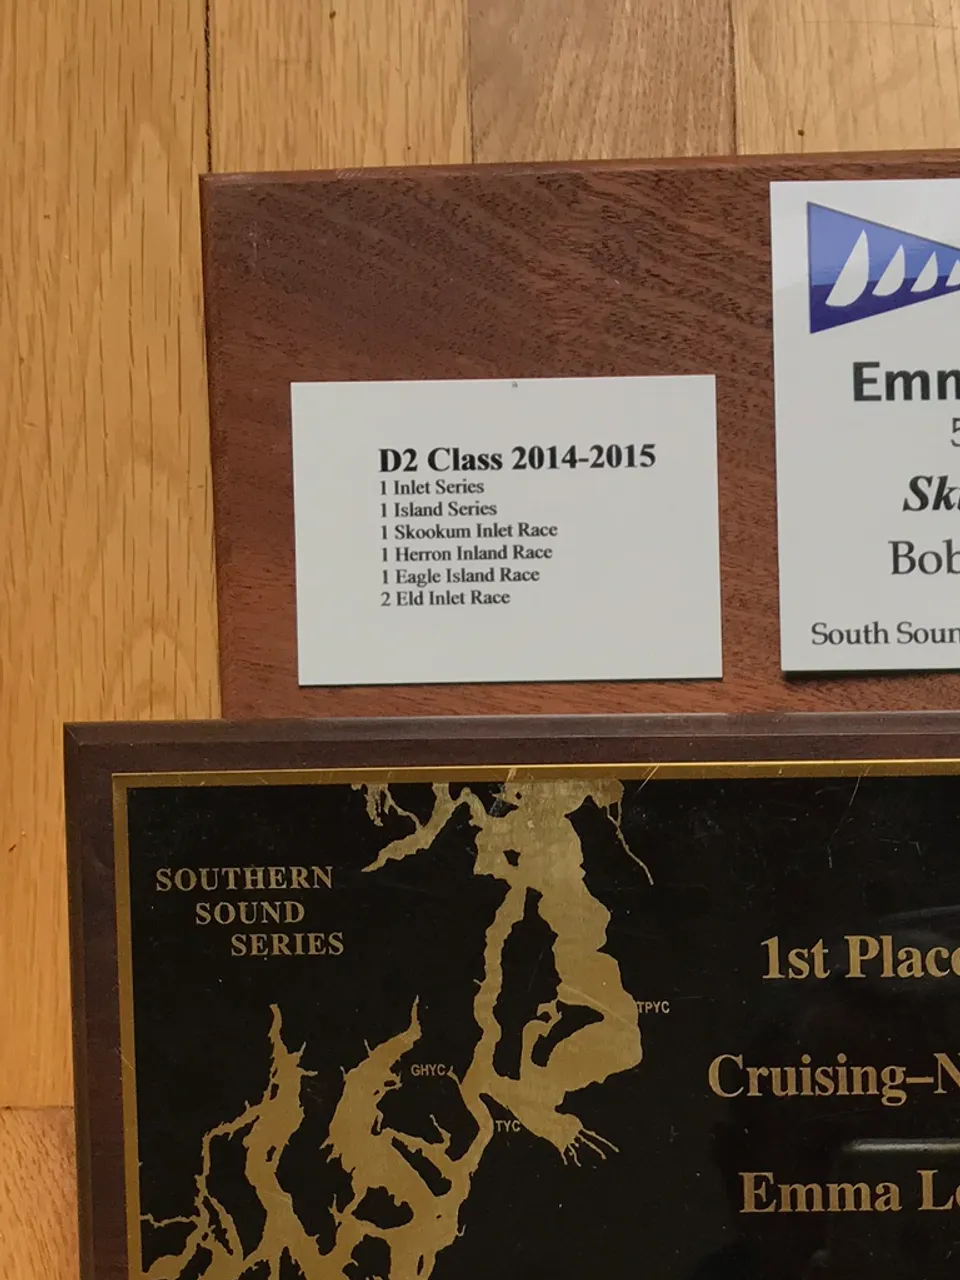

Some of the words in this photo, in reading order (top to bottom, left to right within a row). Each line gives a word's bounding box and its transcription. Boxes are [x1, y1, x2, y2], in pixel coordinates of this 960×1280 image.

[380, 449, 417, 472] D2
[428, 448, 502, 471] Class
[512, 444, 655, 469] 2014-2015
[381, 481, 386, 495] 1
[395, 480, 430, 494] Inlet
[436, 479, 484, 494] Series
[382, 503, 386, 517] 1
[395, 502, 442, 517] Island
[448, 501, 497, 516] Series
[382, 526, 387, 539] 1
[395, 524, 470, 539] Skookum
[477, 523, 512, 537] Inlet
[518, 523, 557, 537] Race
[383, 548, 387, 561] 1
[396, 547, 451, 561] Herron
[458, 545, 507, 560] Inland
[513, 545, 552, 559] Race
[383, 570, 388, 584] 1
[396, 569, 440, 587] Eagle
[447, 568, 494, 583] Island
[501, 568, 539, 581] Race
[381, 592, 390, 606] 2
[397, 591, 423, 606] Eld
[430, 591, 465, 605] Inlet
[471, 590, 510, 604] Race
[812, 621, 889, 644] South
[157, 866, 332, 891] SOUTHERN
[196, 901, 304, 924] SOUND
[232, 932, 343, 956] SERIES
[761, 936, 830, 979] 1st
[636, 1001, 670, 1014] TPYC
[411, 1064, 446, 1076] GHYC
[495, 1120, 520, 1132] TYC
[739, 1172, 902, 1212] Emma
